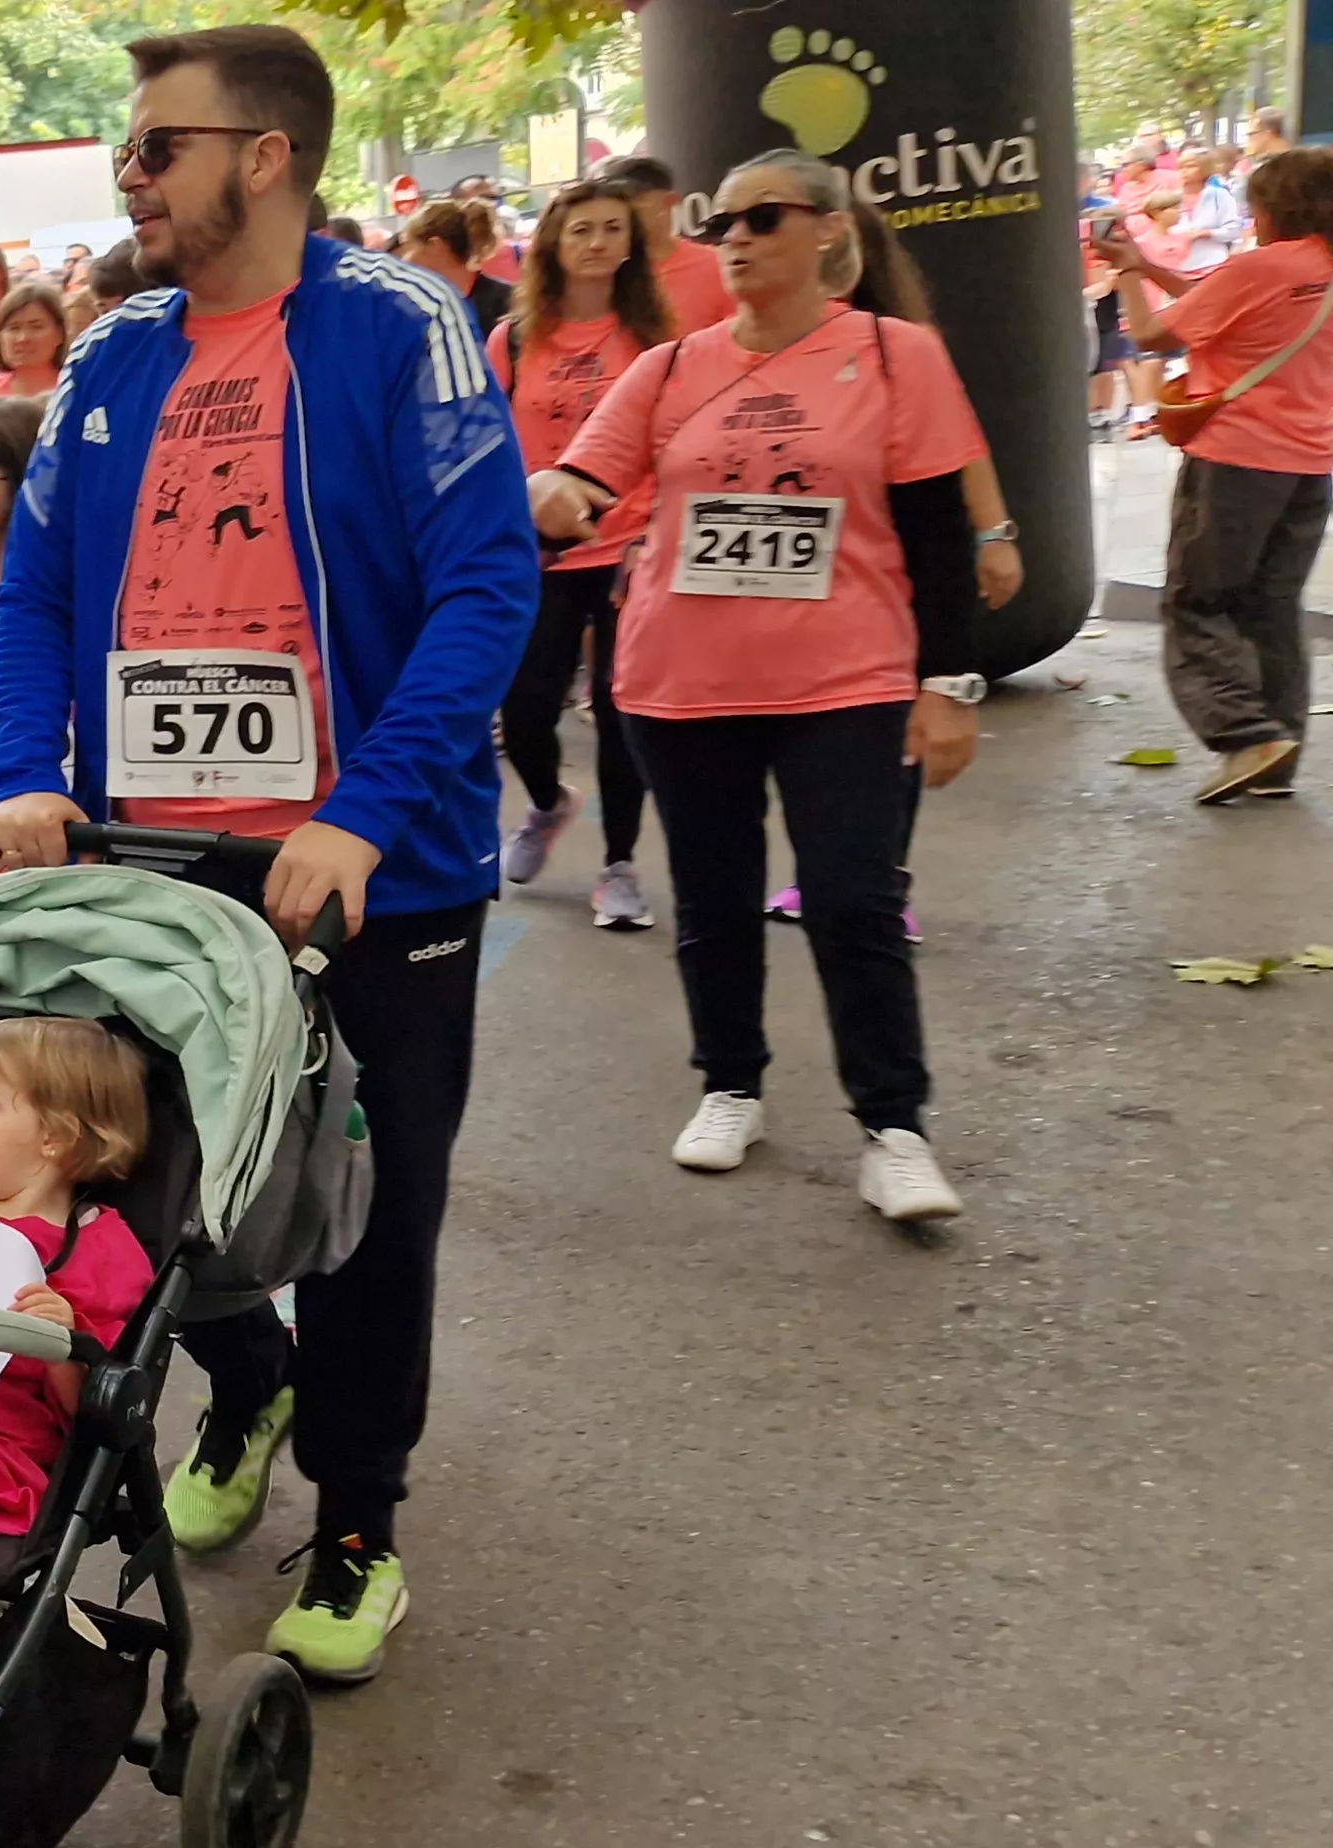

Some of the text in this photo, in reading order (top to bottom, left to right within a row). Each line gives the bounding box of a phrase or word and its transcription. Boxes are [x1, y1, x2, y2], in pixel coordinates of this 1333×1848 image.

[694, 528, 816, 569] 2419
[131, 675, 291, 695] CONTRA EL CÁNCER
[151, 701, 274, 755] 570
[408, 937, 468, 962] adidas
